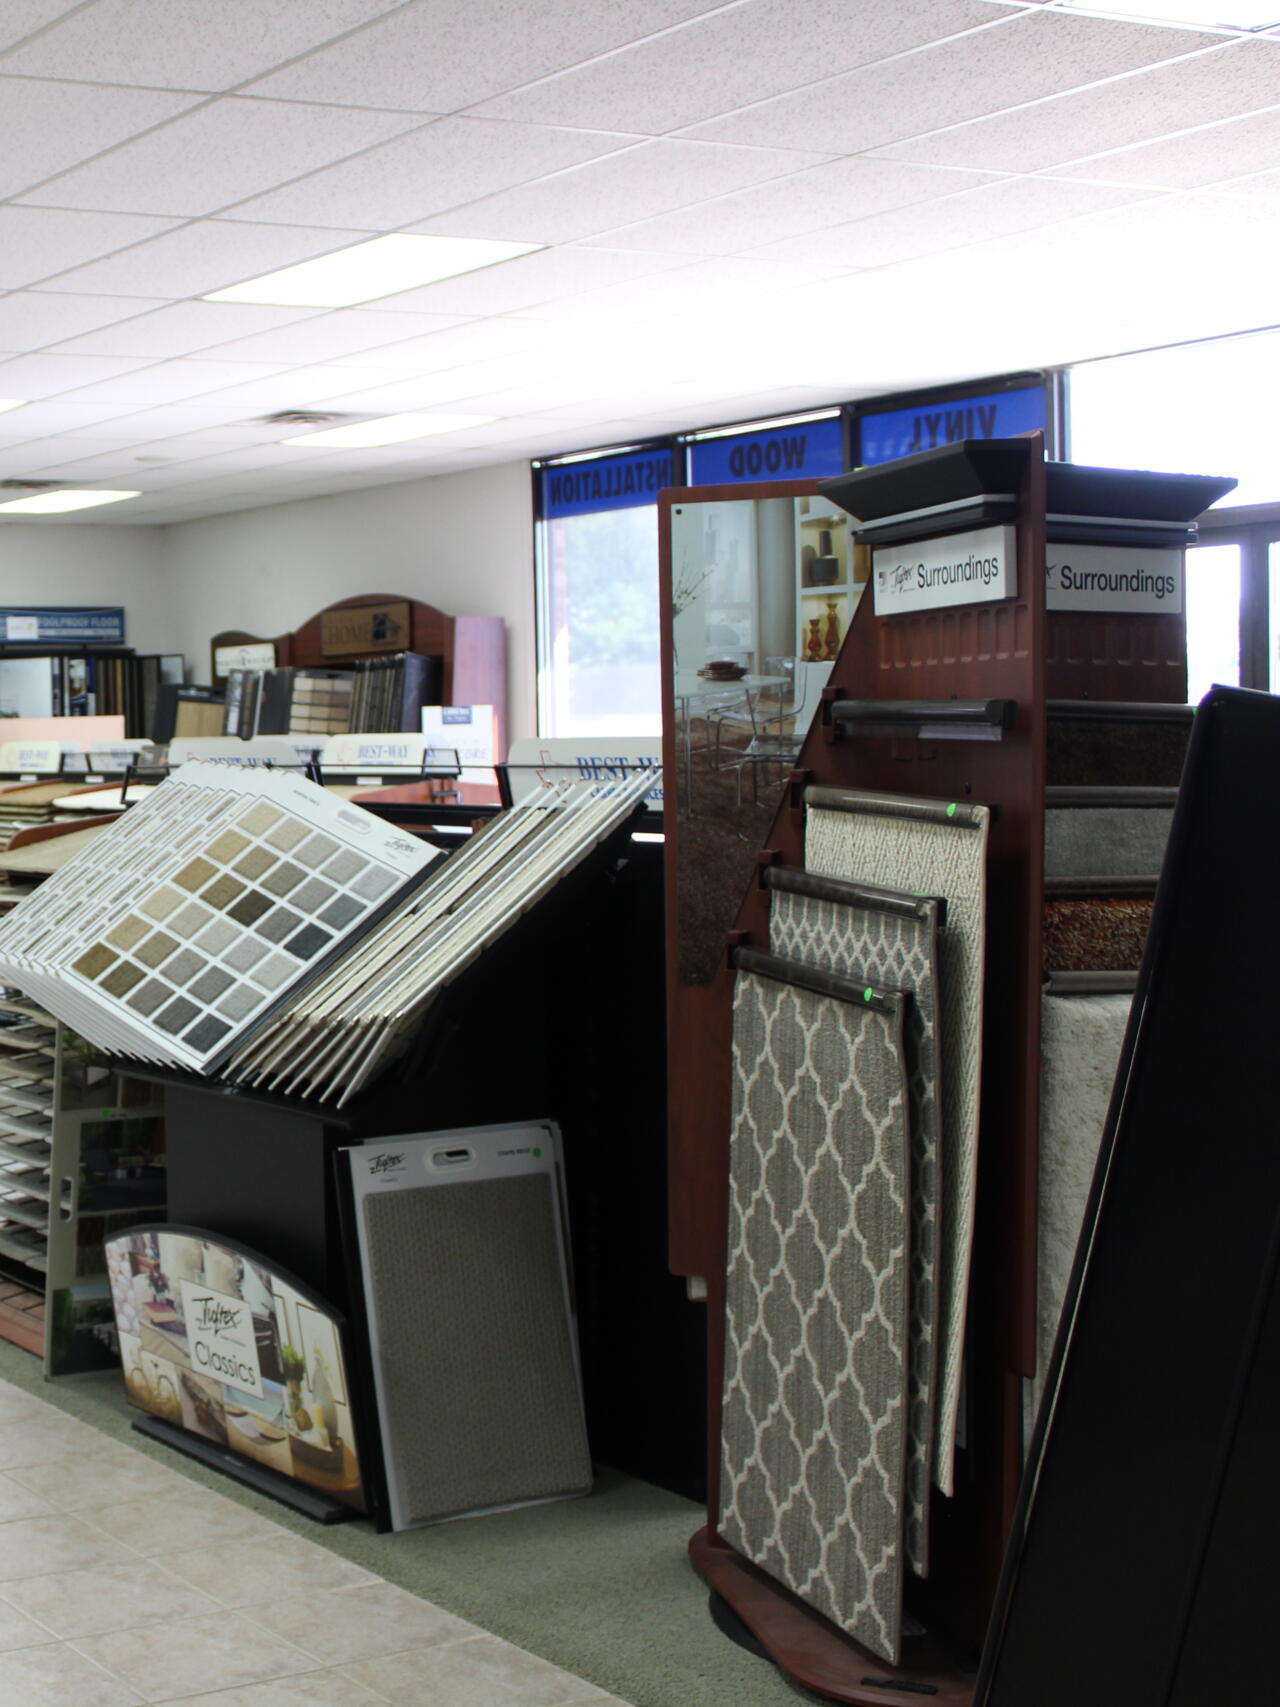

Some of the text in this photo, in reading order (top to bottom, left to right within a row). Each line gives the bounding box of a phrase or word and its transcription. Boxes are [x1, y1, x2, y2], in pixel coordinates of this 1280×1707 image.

[917, 554, 999, 589] Surroundings
[1060, 565, 1175, 599] Surroundings
[357, 744, 409, 759] BEST-WAY
[577, 756, 660, 782] BEST-W
[195, 1341, 255, 1386] Classics
